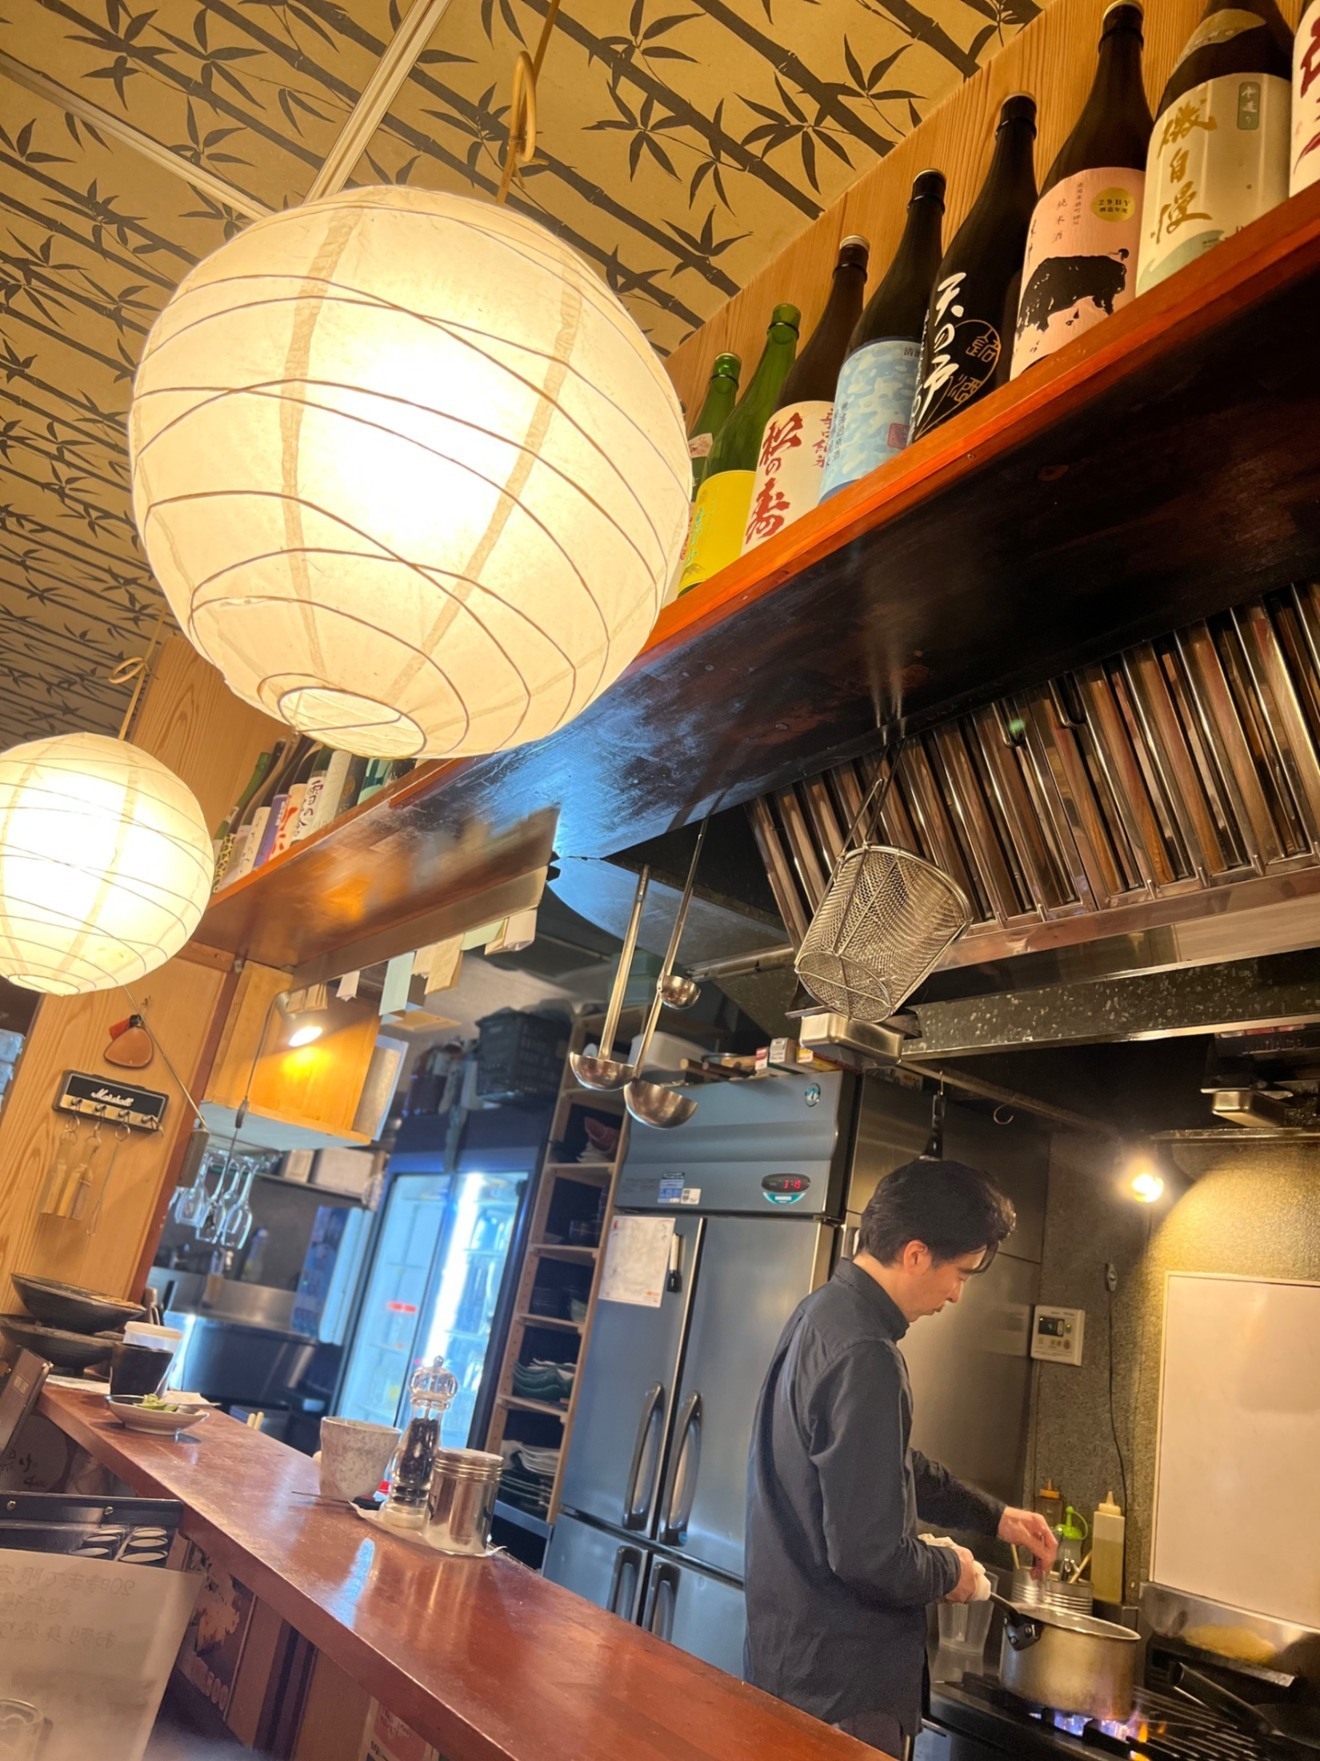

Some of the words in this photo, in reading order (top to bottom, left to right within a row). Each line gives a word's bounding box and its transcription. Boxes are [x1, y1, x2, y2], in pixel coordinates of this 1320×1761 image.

[1150, 97, 1218, 245] 磯自慢
[917, 271, 967, 427] 天の戸
[745, 411, 804, 545] 松の寿
[91, 1087, 134, 1107] Marshall
